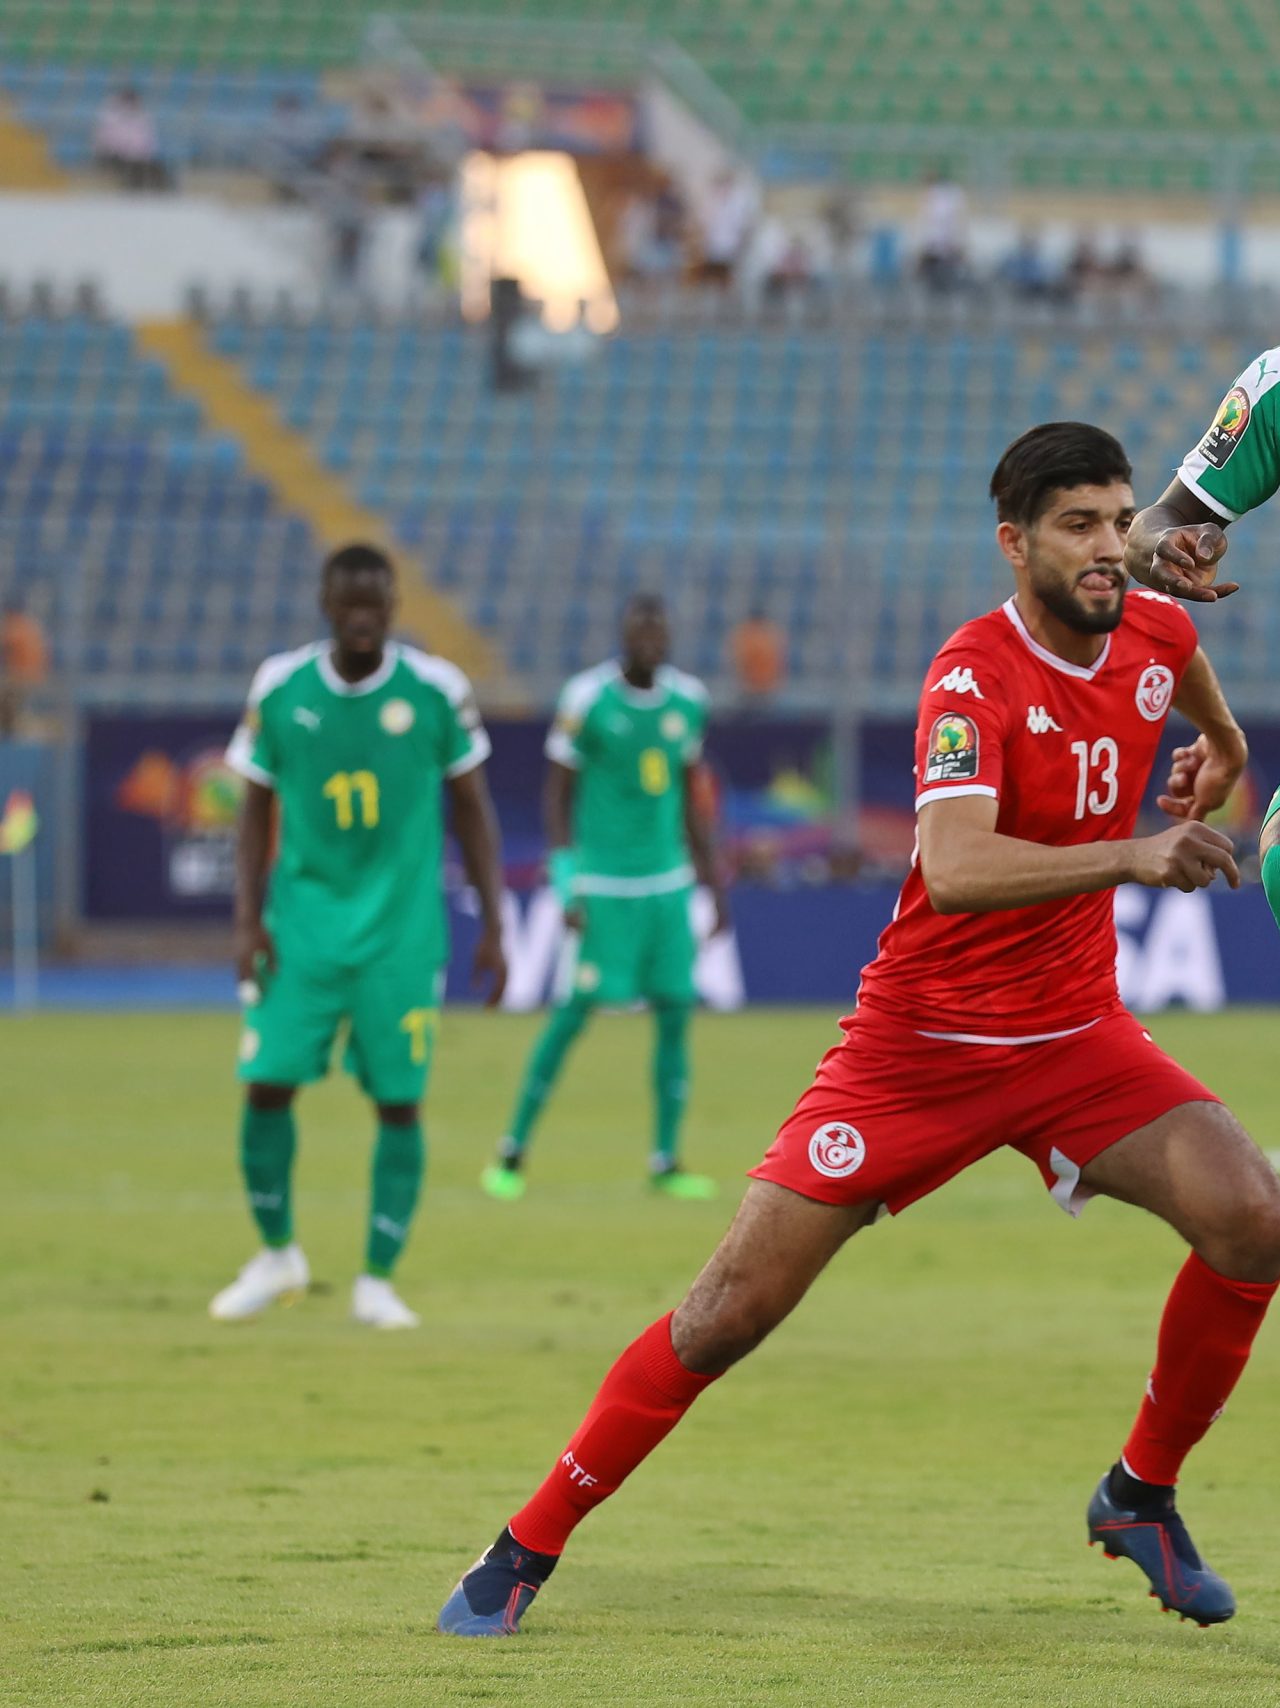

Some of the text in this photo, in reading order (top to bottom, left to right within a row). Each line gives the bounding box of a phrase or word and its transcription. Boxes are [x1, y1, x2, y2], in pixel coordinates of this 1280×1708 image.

[1212, 426, 1230, 441] AF
[322, 769, 380, 831] 11
[1071, 736, 1119, 820] 13
[561, 1451, 598, 1487] FTF
